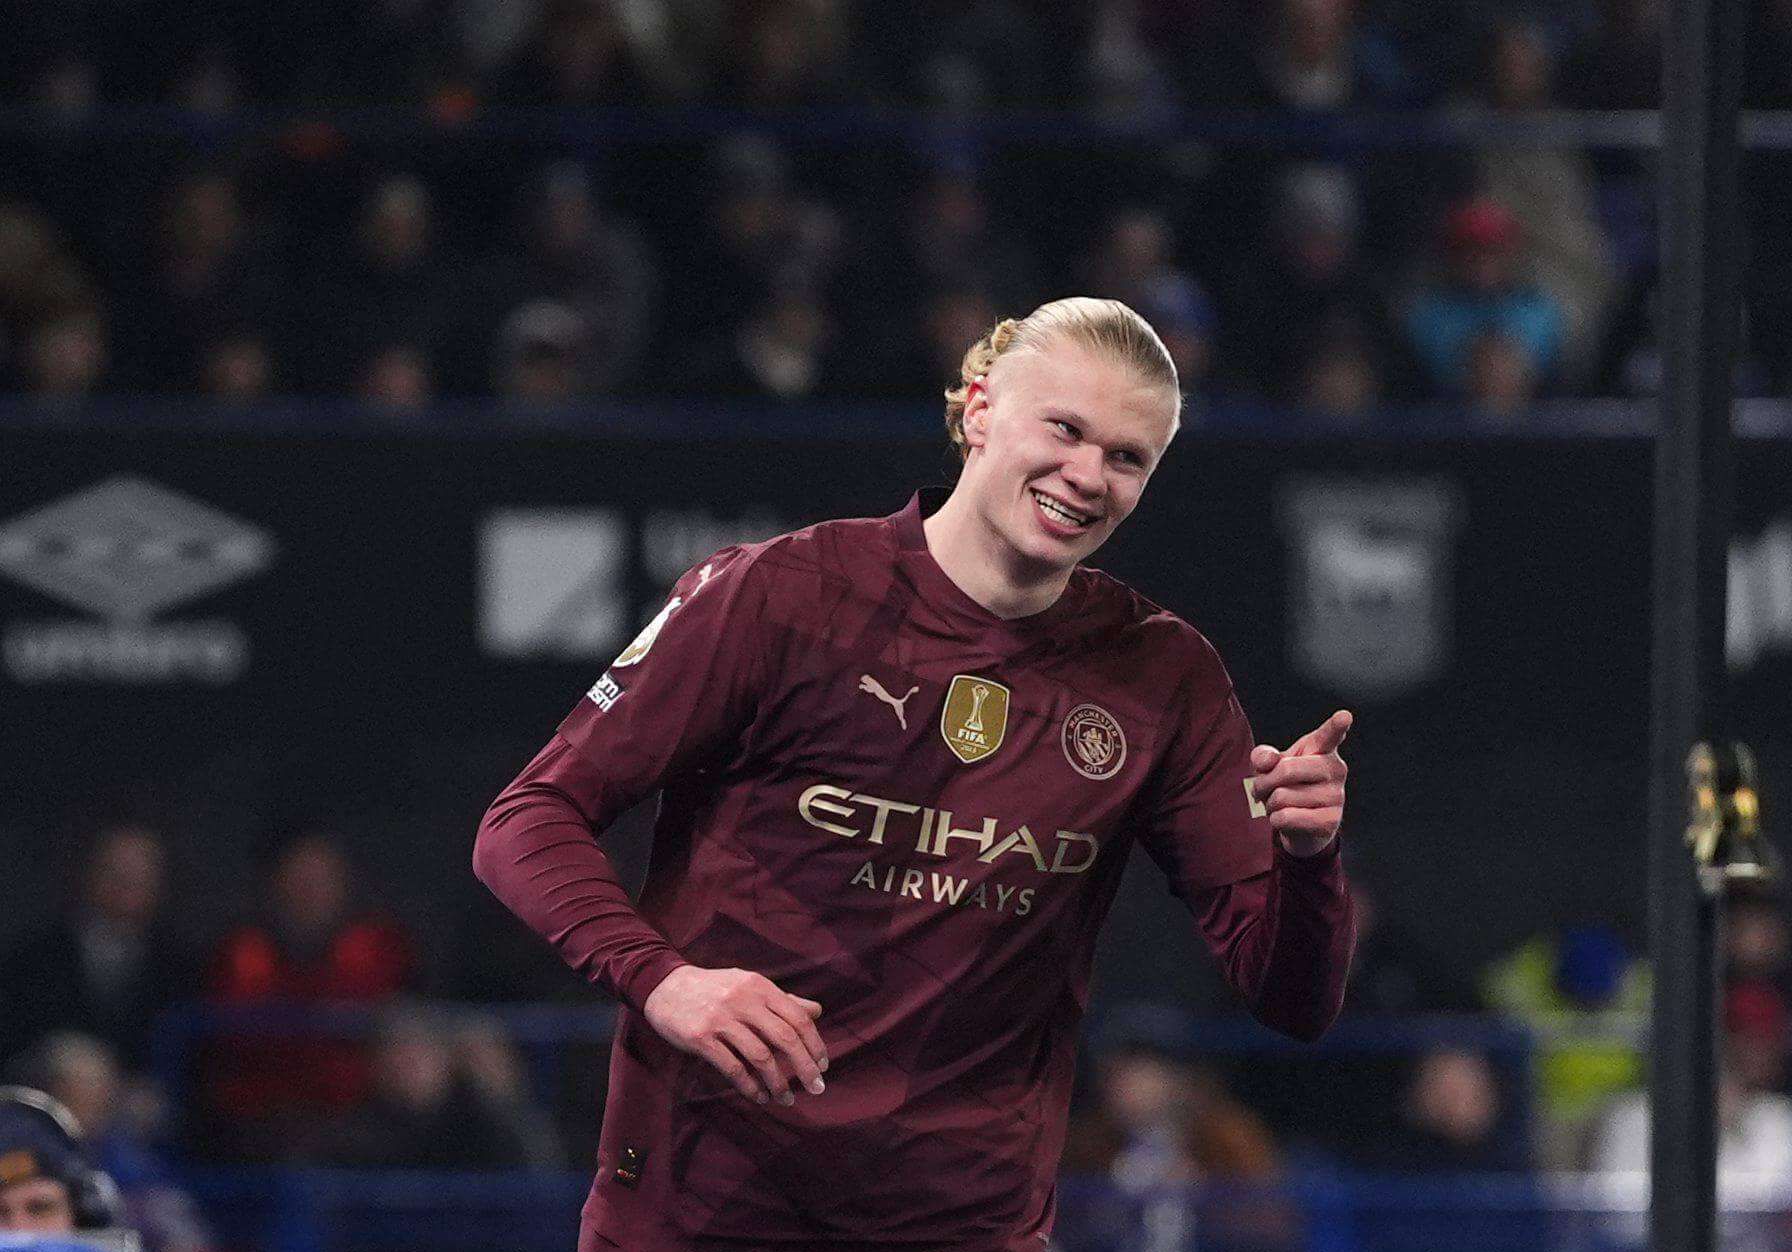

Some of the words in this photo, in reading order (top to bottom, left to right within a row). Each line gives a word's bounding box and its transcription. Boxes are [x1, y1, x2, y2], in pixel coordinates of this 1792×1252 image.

[958, 728, 986, 744] FIFA
[798, 784, 1099, 873] ETIHAD
[850, 861, 1036, 917] AIRWAYS
